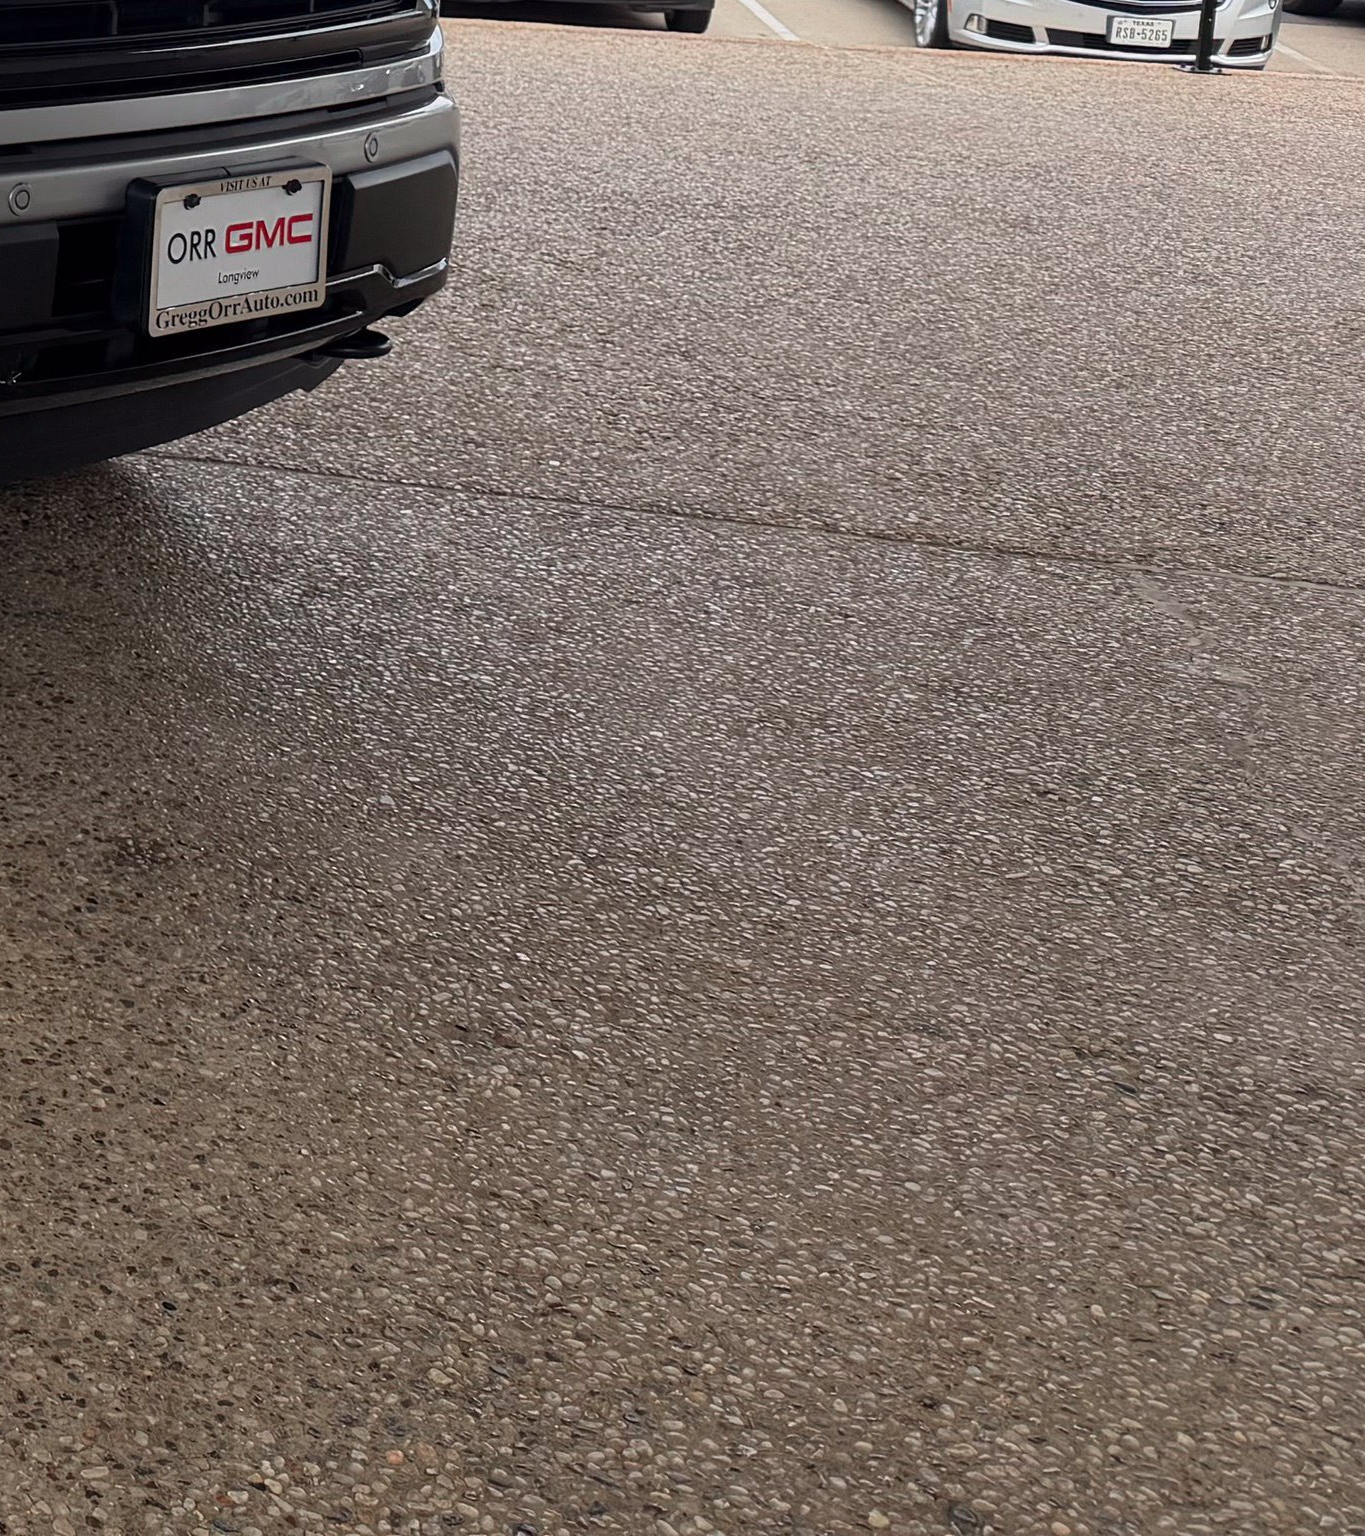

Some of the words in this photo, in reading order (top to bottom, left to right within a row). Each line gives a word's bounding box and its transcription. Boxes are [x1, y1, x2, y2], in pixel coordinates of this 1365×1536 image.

[167, 228, 217, 265] ORR
[225, 213, 314, 254] GMC
[218, 267, 260, 285] Longview
[155, 288, 319, 330] GreggOrrAuto.com
